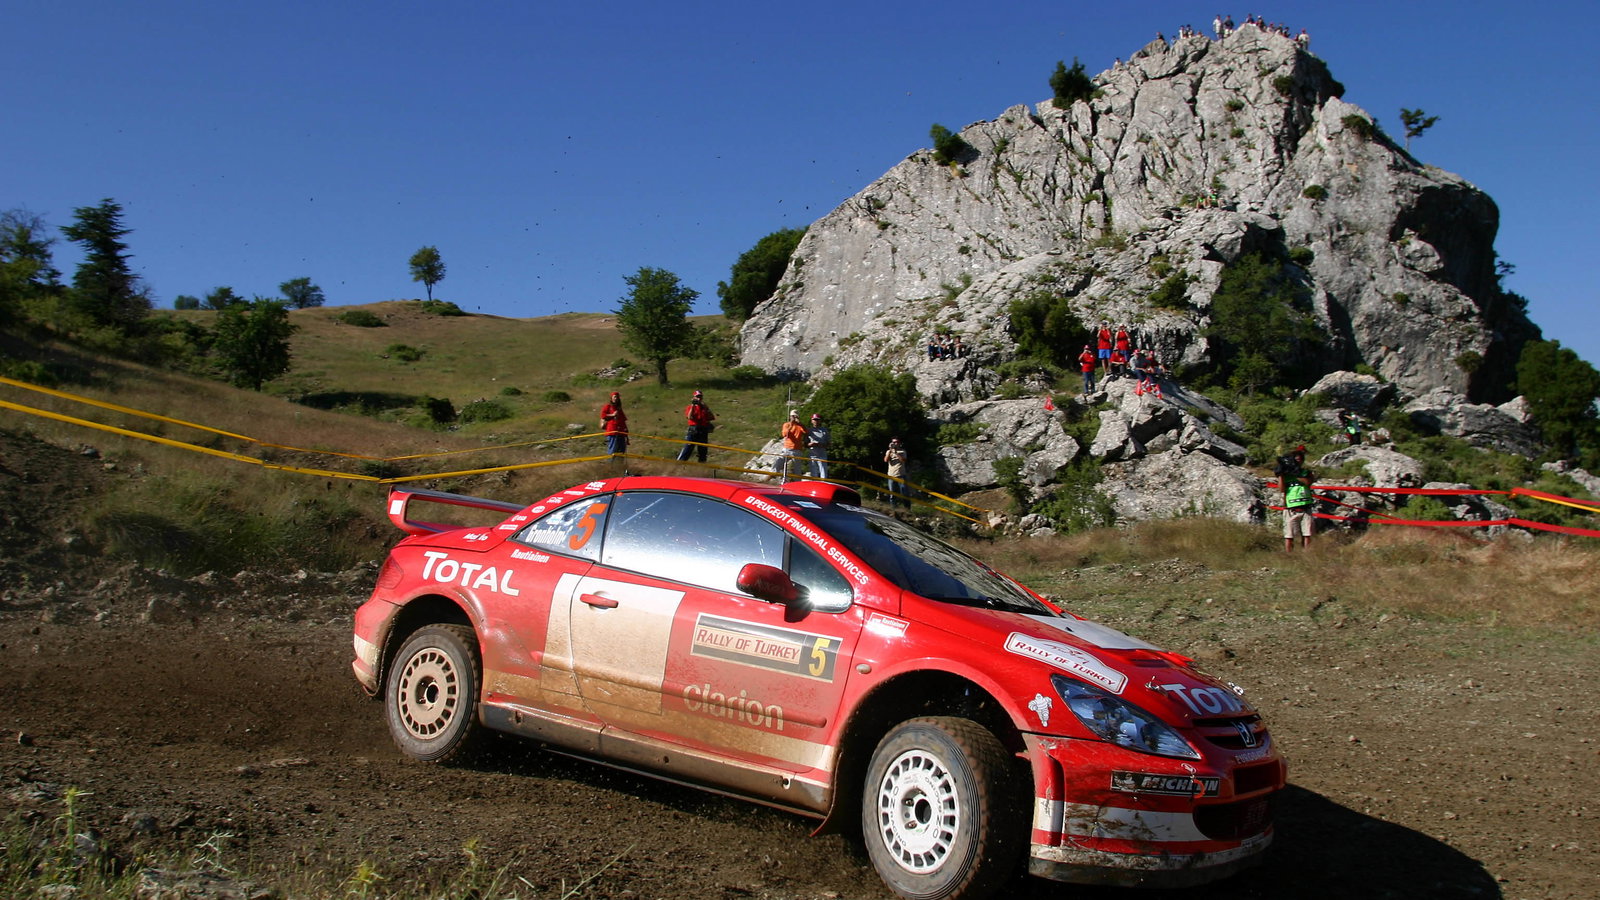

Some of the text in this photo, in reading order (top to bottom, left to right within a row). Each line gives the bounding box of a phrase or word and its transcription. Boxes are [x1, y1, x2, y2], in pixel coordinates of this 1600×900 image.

[569, 503, 608, 550] 5
[752, 499, 790, 521] PEUGEOT
[787, 517, 827, 551] FINANCIAL
[828, 547, 869, 585] SERVICES
[422, 550, 520, 597] TOTAL
[696, 629, 800, 660] RALLY OF TURKEY
[808, 637, 831, 677] 5
[1015, 641, 1116, 686] RALLY OF TURKEY
[683, 683, 784, 731] clarion
